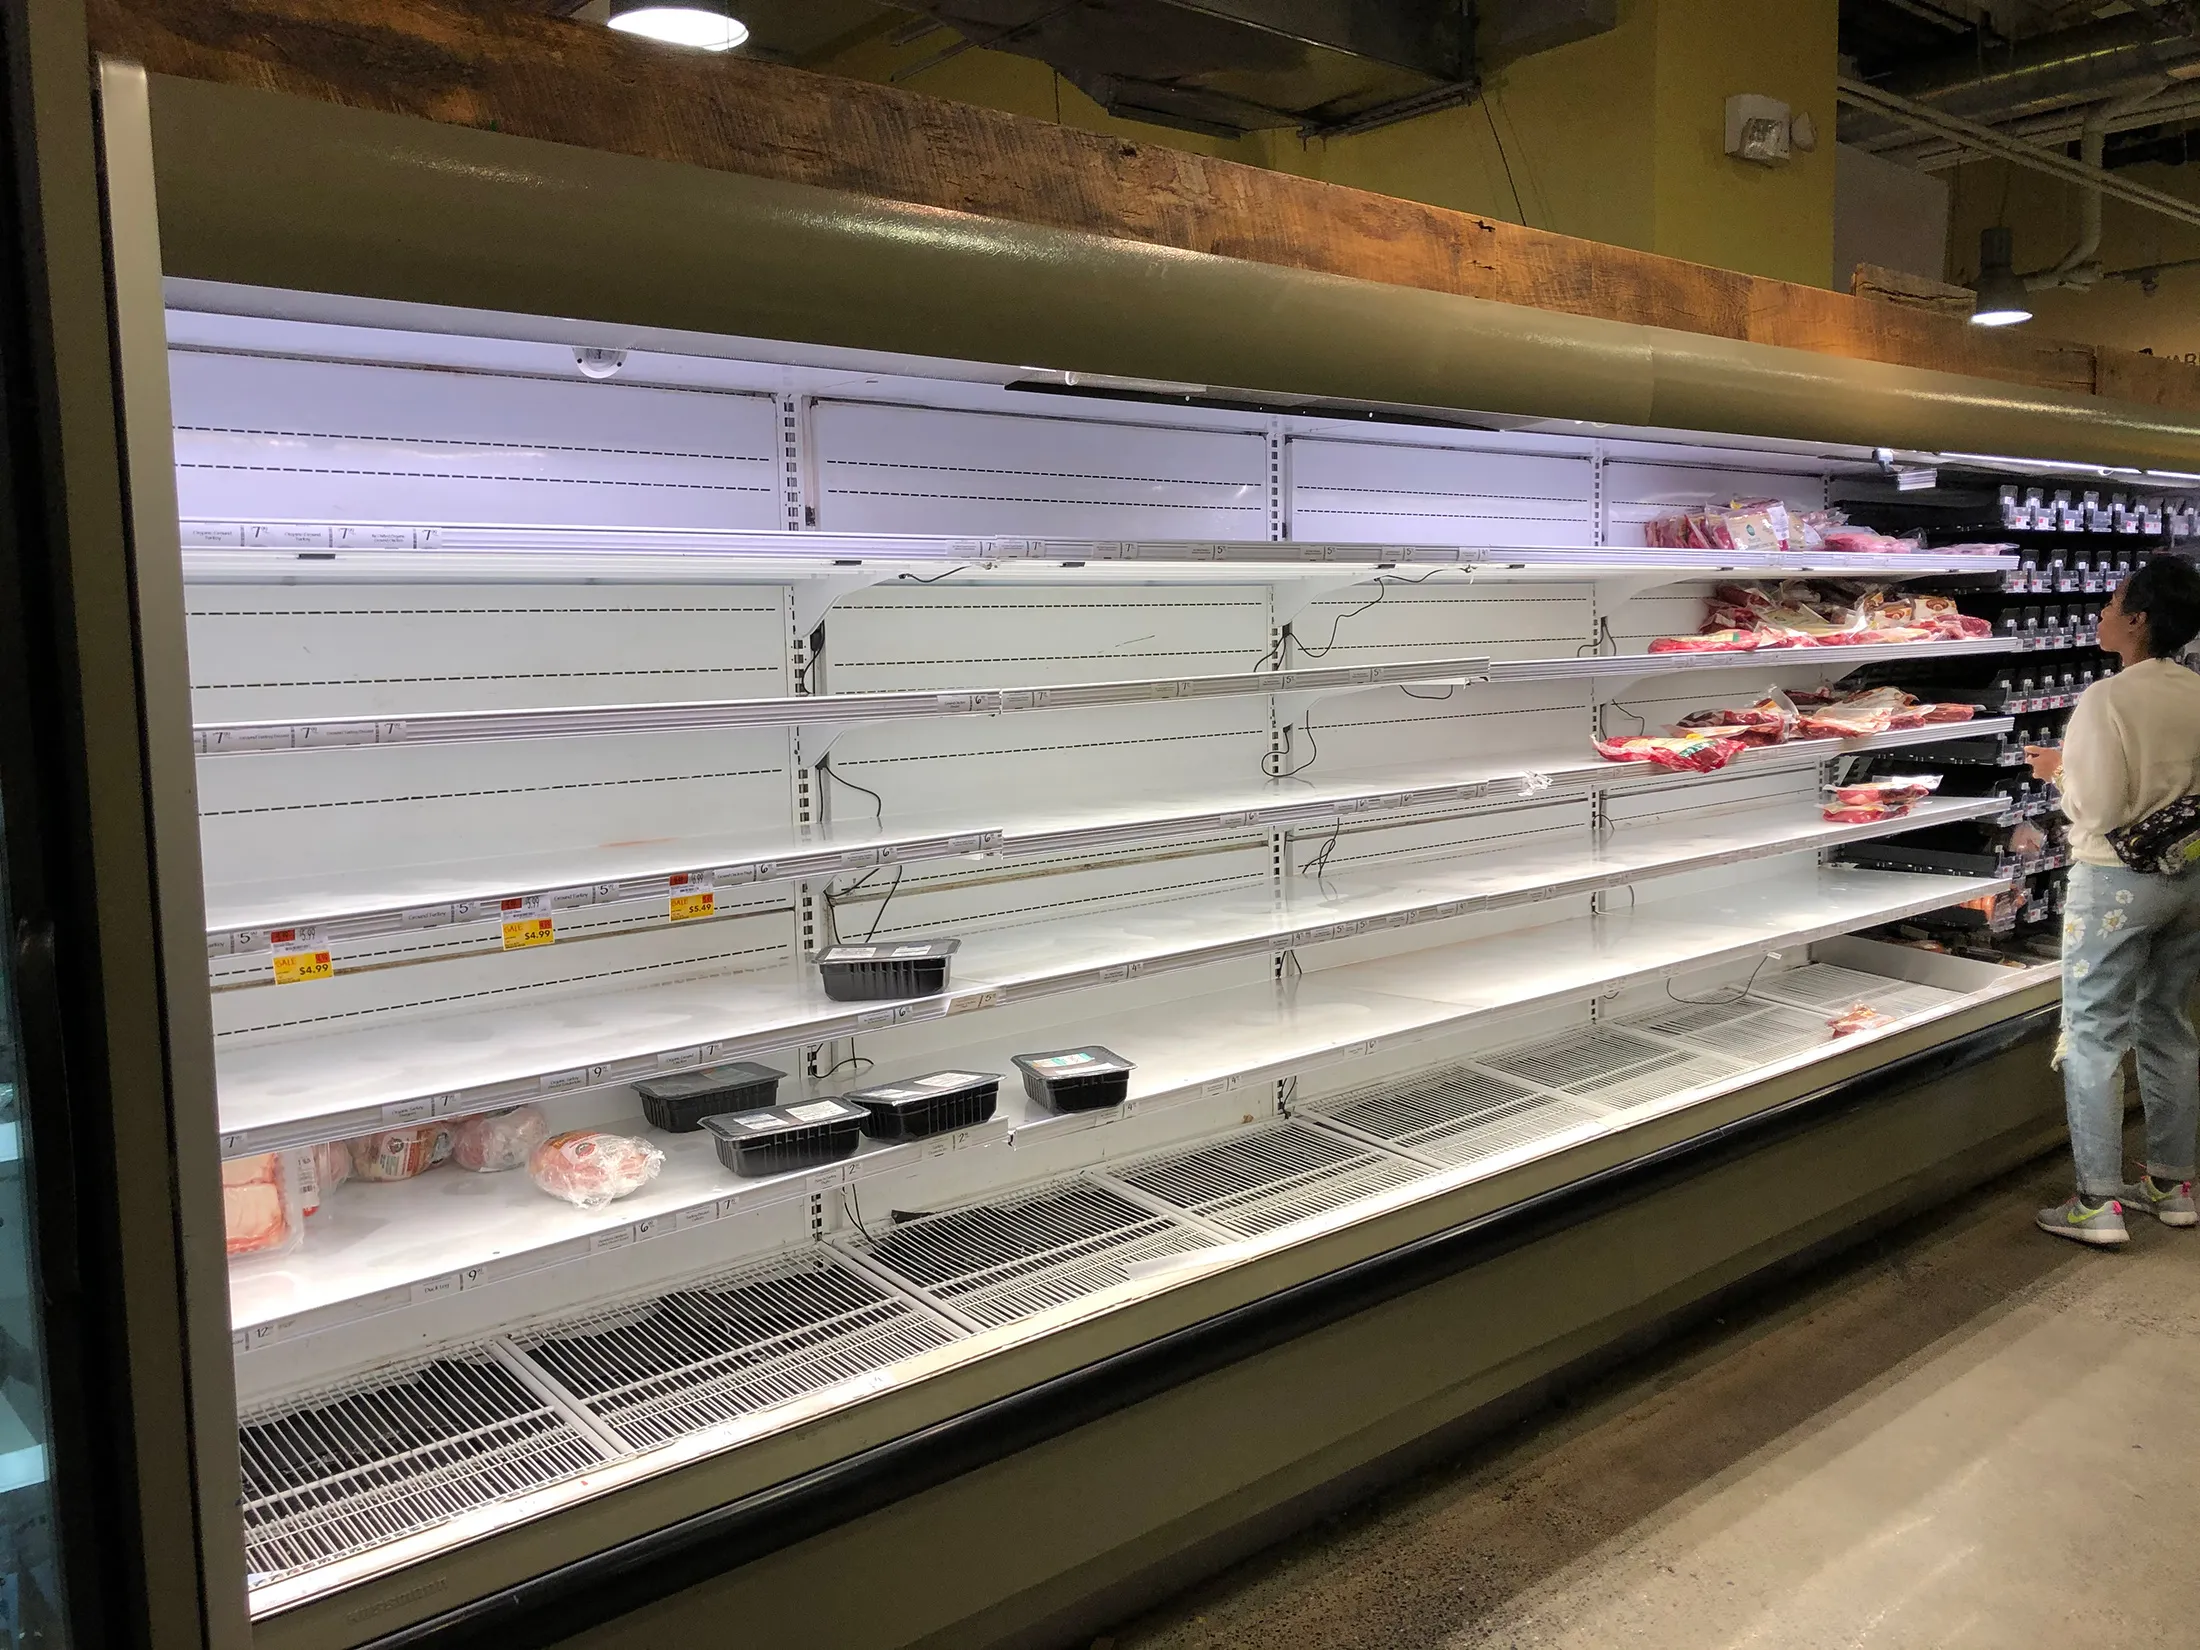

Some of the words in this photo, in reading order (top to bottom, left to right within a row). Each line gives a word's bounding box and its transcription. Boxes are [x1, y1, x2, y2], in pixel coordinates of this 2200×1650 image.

[689, 903, 711, 913] $5.49
[525, 930, 551, 940] $4.99
[299, 964, 329, 976] $4.99
